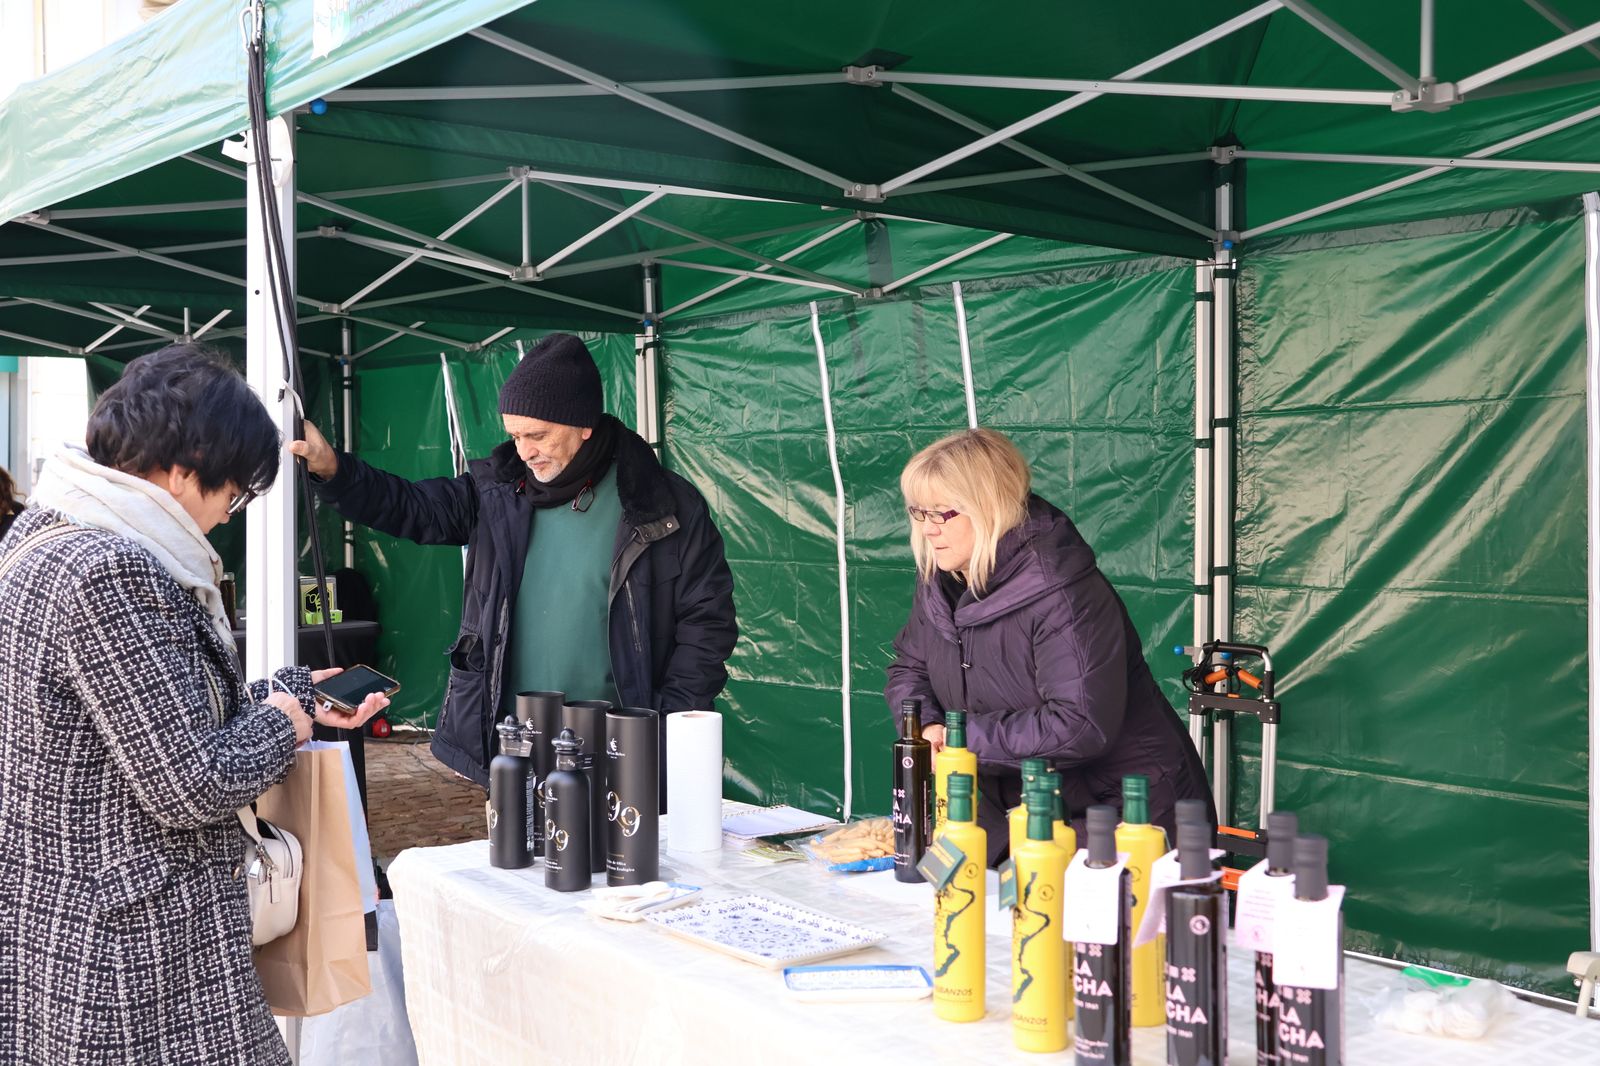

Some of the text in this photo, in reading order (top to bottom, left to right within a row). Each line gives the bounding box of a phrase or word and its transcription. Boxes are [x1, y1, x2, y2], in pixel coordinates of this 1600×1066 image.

[1165, 1000, 1208, 1025] CHA
[1279, 1002, 1302, 1026] LA
[1279, 1022, 1325, 1049] CHA
